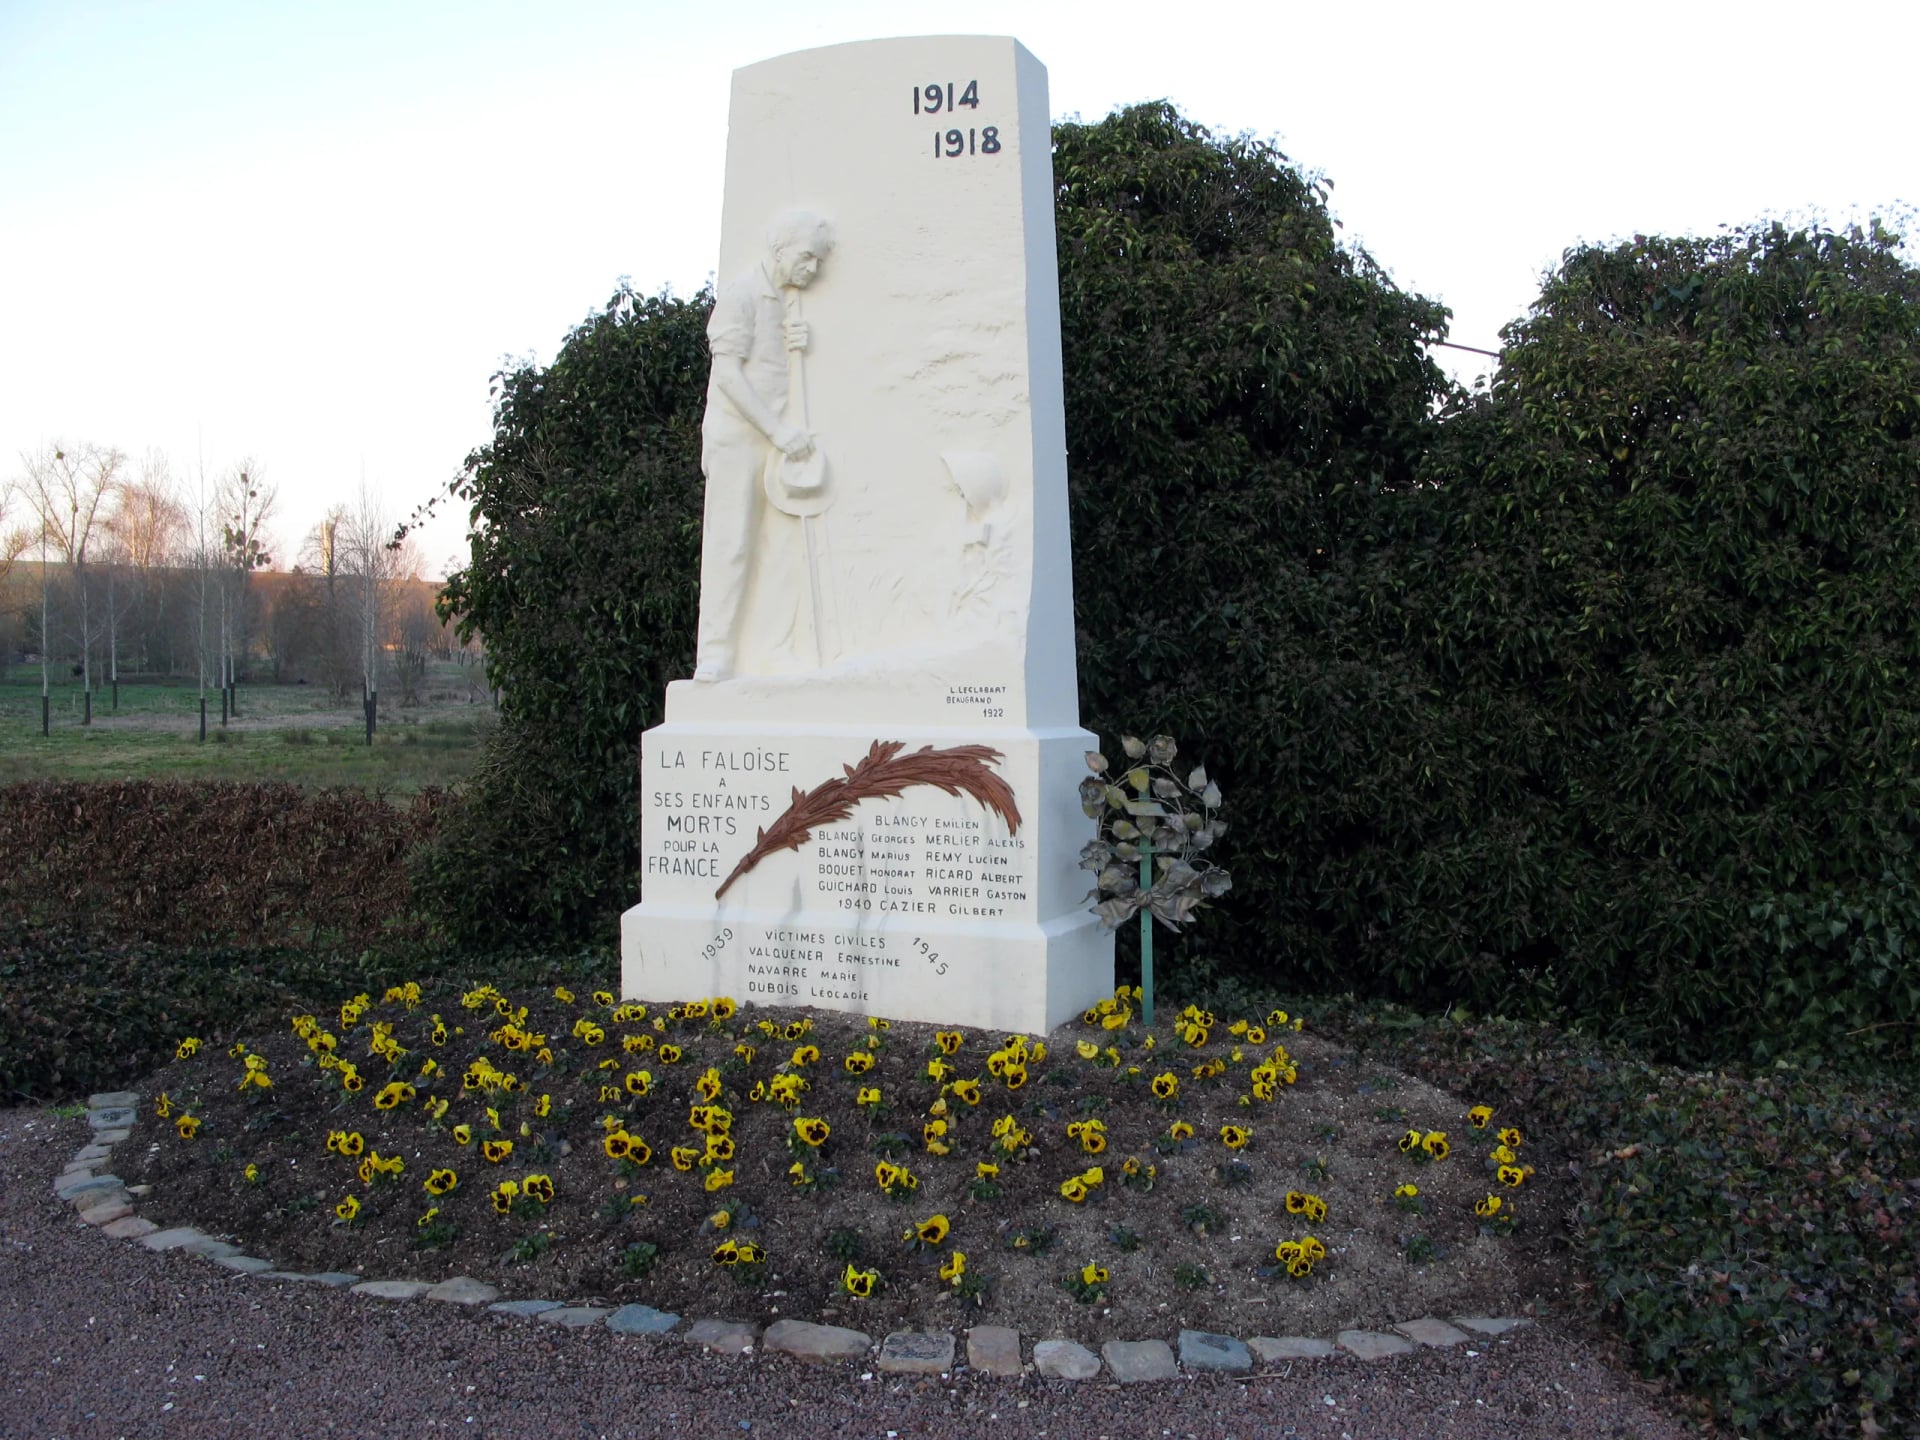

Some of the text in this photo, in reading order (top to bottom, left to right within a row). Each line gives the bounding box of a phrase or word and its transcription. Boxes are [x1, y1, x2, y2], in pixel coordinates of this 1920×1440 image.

[914, 80, 979, 114] 1914
[935, 126, 1001, 158] 1918
[983, 708, 1004, 718] 1922
[661, 751, 685, 768] LA
[654, 792, 770, 811] SES ENFANTS
[667, 815, 736, 835] MORTS
[875, 815, 979, 829] BLANGY EMILIEN
[818, 830, 915, 844] BLANGY GEORGES
[926, 833, 1024, 849] MERLIER ALEXIS
[664, 840, 719, 853] POUR LA
[818, 847, 910, 861] BLANGY MARIUS
[648, 856, 719, 877] FRANCE
[926, 851, 1008, 865] REMY LUCIEN
[818, 863, 915, 878] BOQUET HONORAT
[926, 867, 1023, 884] RICARD ALBERT
[818, 880, 913, 895] GUICHARD LOUIS
[928, 885, 1026, 901] VARRIER GASTON
[838, 898, 1004, 916] 1940 CAZIER GILBERT
[701, 927, 733, 961] 1939
[765, 929, 886, 949] VICTIMES CIVILES
[749, 946, 901, 967] VALQUENER ERNESTINE
[912, 937, 949, 976] 1945
[748, 963, 857, 982] NAVARRE MARIE
[749, 981, 799, 996] DUBOIS
